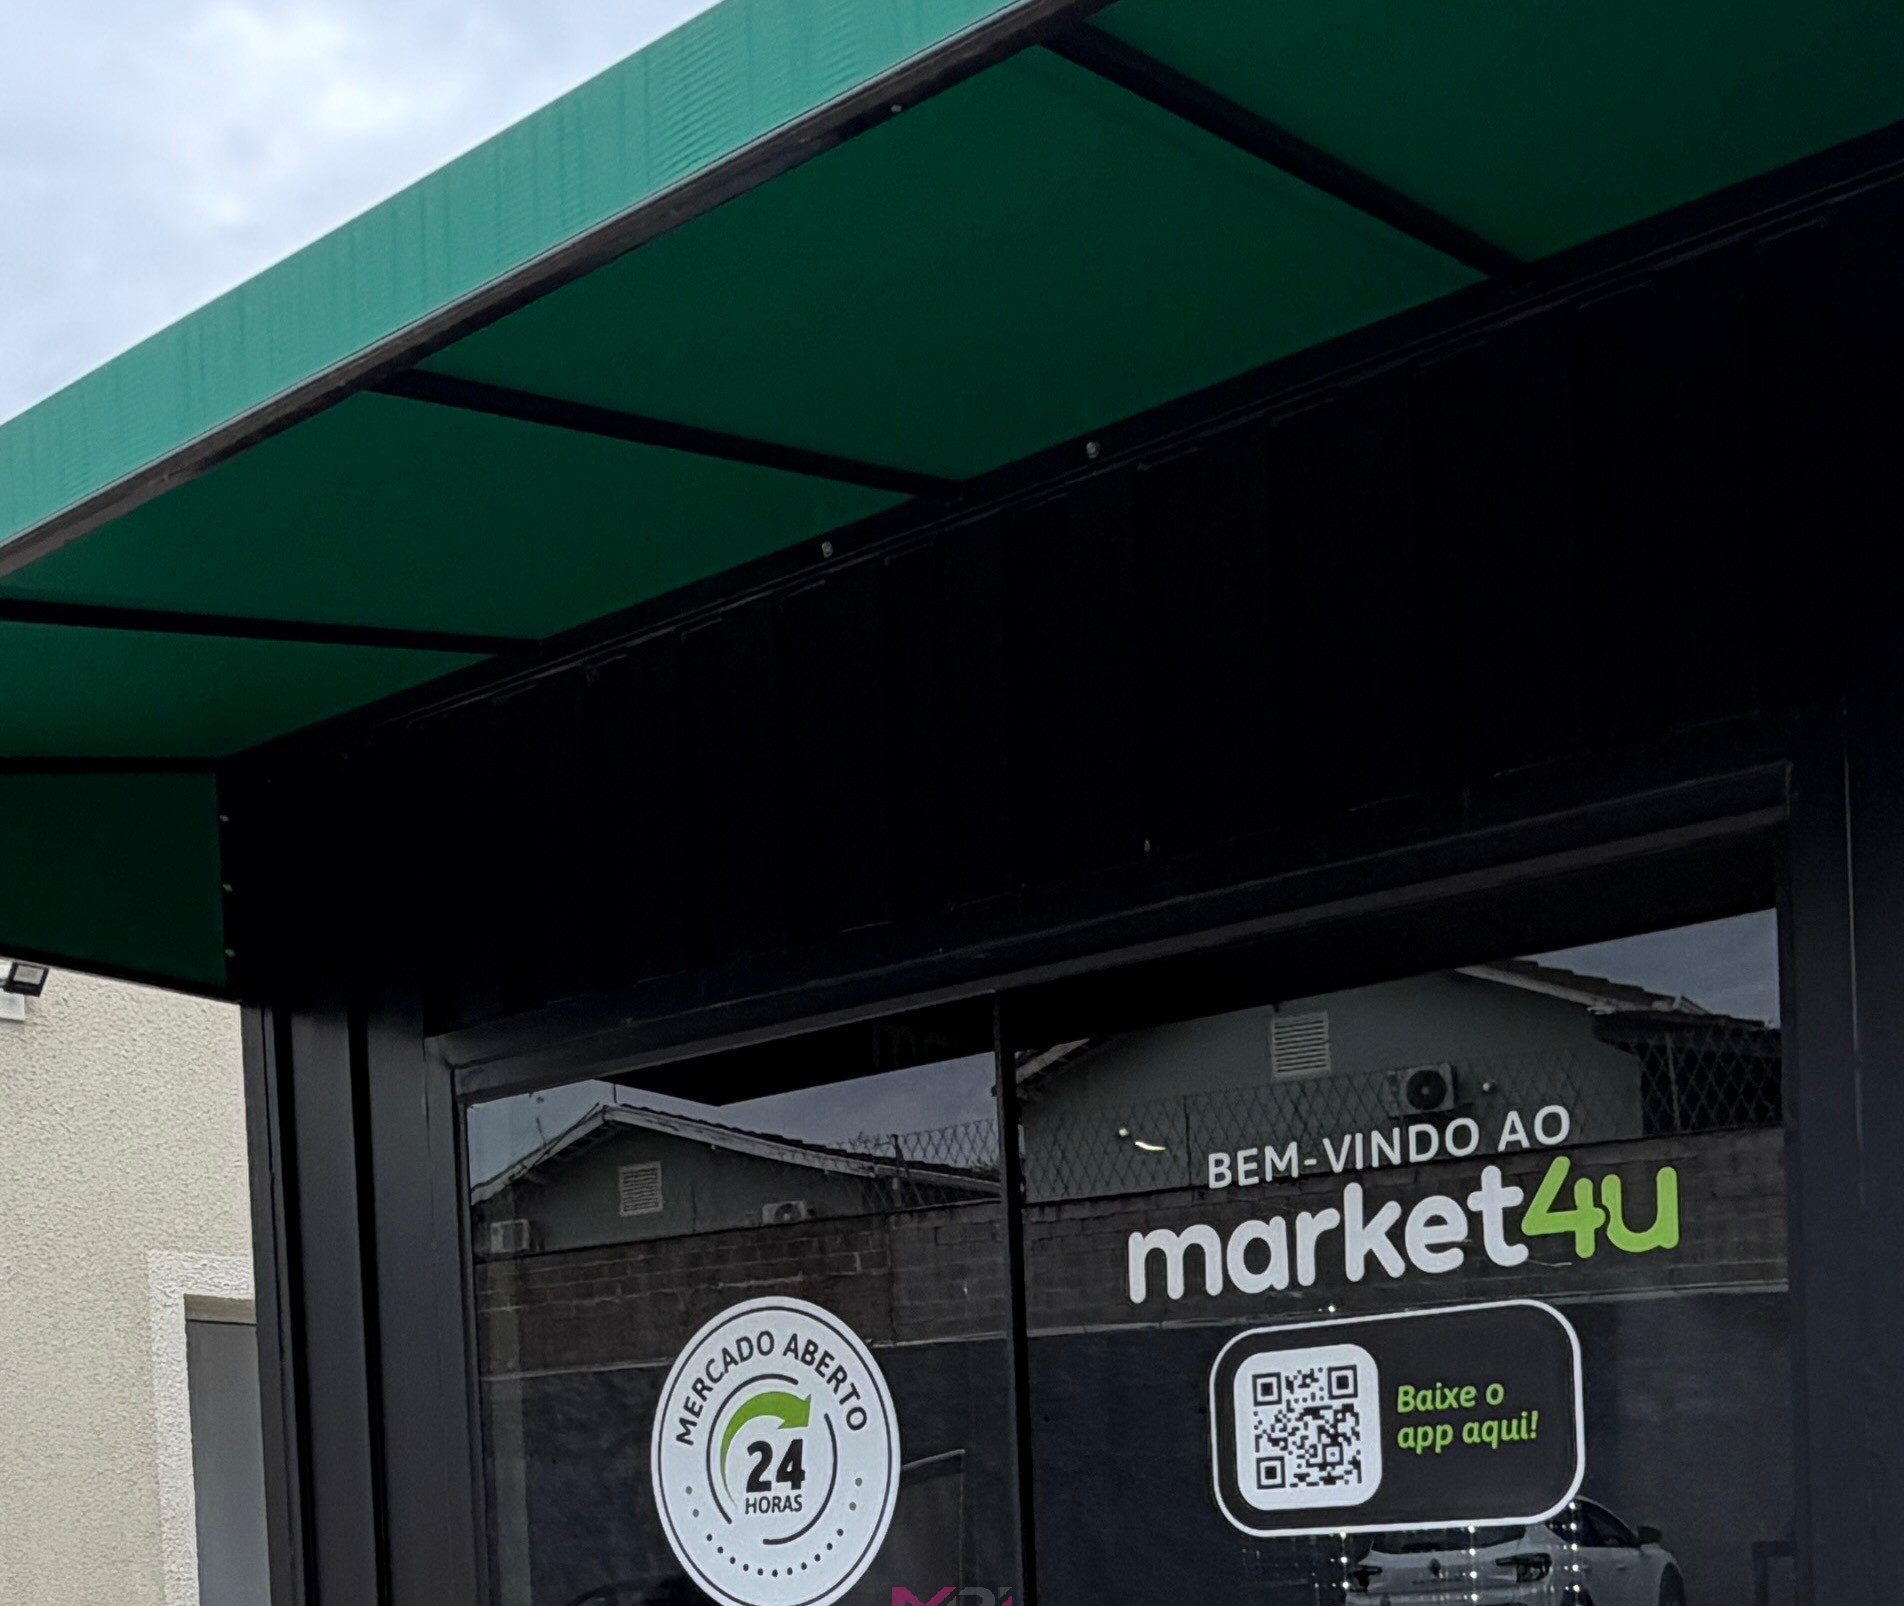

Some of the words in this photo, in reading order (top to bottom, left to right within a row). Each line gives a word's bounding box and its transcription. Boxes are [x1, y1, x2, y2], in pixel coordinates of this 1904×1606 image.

[1207, 1117, 1480, 1188] BEM-VINDO
[1497, 1104, 1571, 1151] AO
[1127, 1155, 1679, 1304] market4u
[676, 1330, 775, 1446] MERCADO
[782, 1332, 868, 1431] ABERTO
[1397, 1382, 1477, 1413] Baixe
[1485, 1383, 1505, 1406] o
[1397, 1423, 1454, 1455] app
[1462, 1410, 1539, 1450] aqui!
[745, 1438, 806, 1493] 24
[744, 1494, 804, 1515] HORAS
